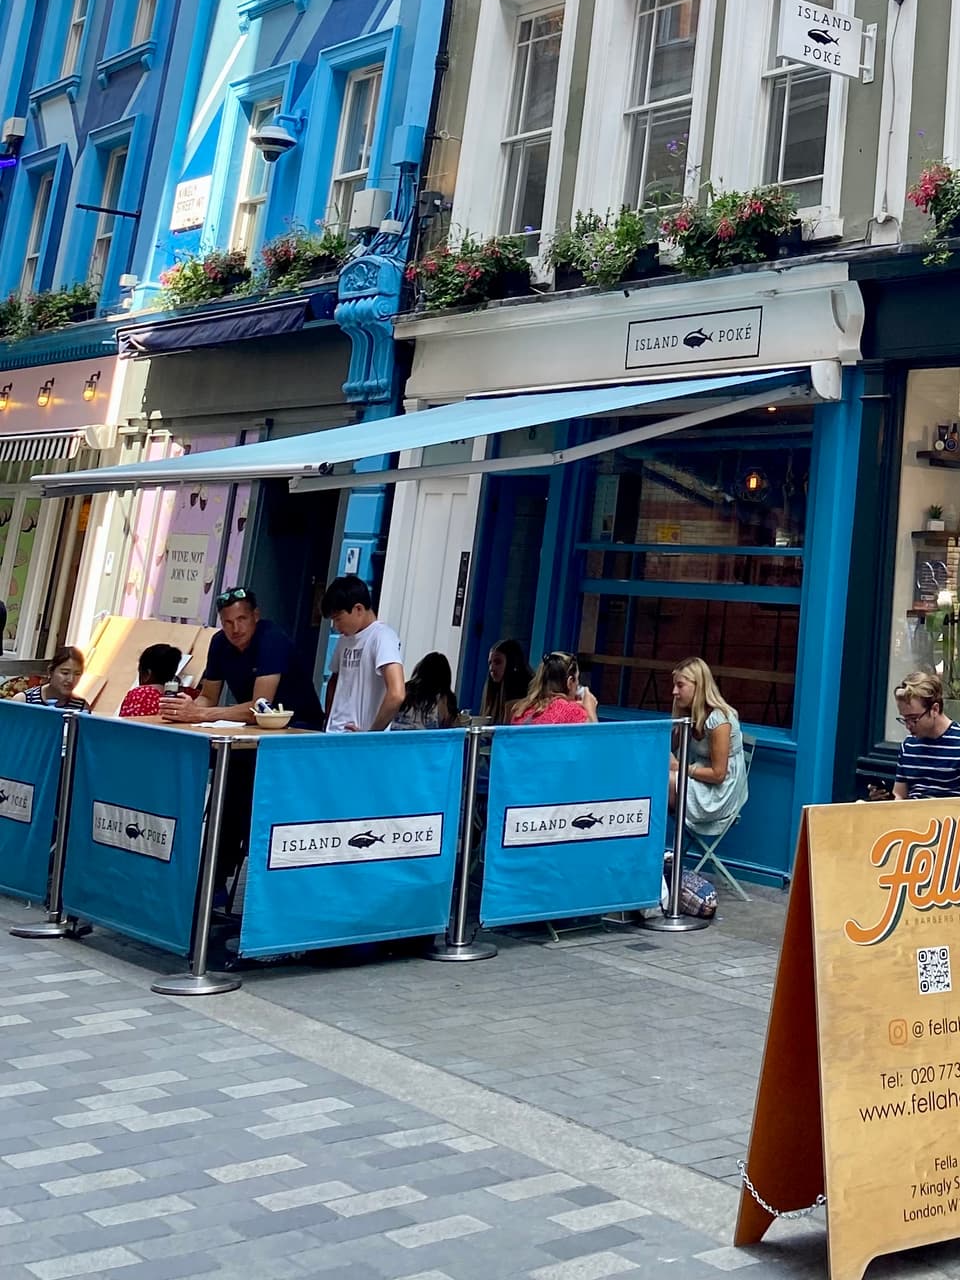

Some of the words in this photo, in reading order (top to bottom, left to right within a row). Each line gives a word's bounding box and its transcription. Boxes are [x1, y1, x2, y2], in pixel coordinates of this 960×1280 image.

[797, 5, 852, 32] ISLAND
[803, 45, 841, 66] POKÉ
[635, 335, 679, 351] ISLAND
[718, 323, 752, 342] POKÉ
[172, 550, 189, 562] WINE
[191, 551, 205, 564] NOT
[170, 568, 185, 580] JOIN
[515, 818, 567, 833] ISLAND
[608, 809, 644, 825] POKÉ
[281, 836, 342, 853] ISLAND
[391, 827, 434, 844] POKÉ
[912, 1021, 925, 1038] @
[880, 1072, 904, 1089] Tel:
[911, 1065, 935, 1085] 020
[934, 1155, 958, 1171] Fella
[911, 1185, 917, 1198] 7
[920, 1178, 951, 1197] Kingly
[903, 1205, 946, 1222] London,
